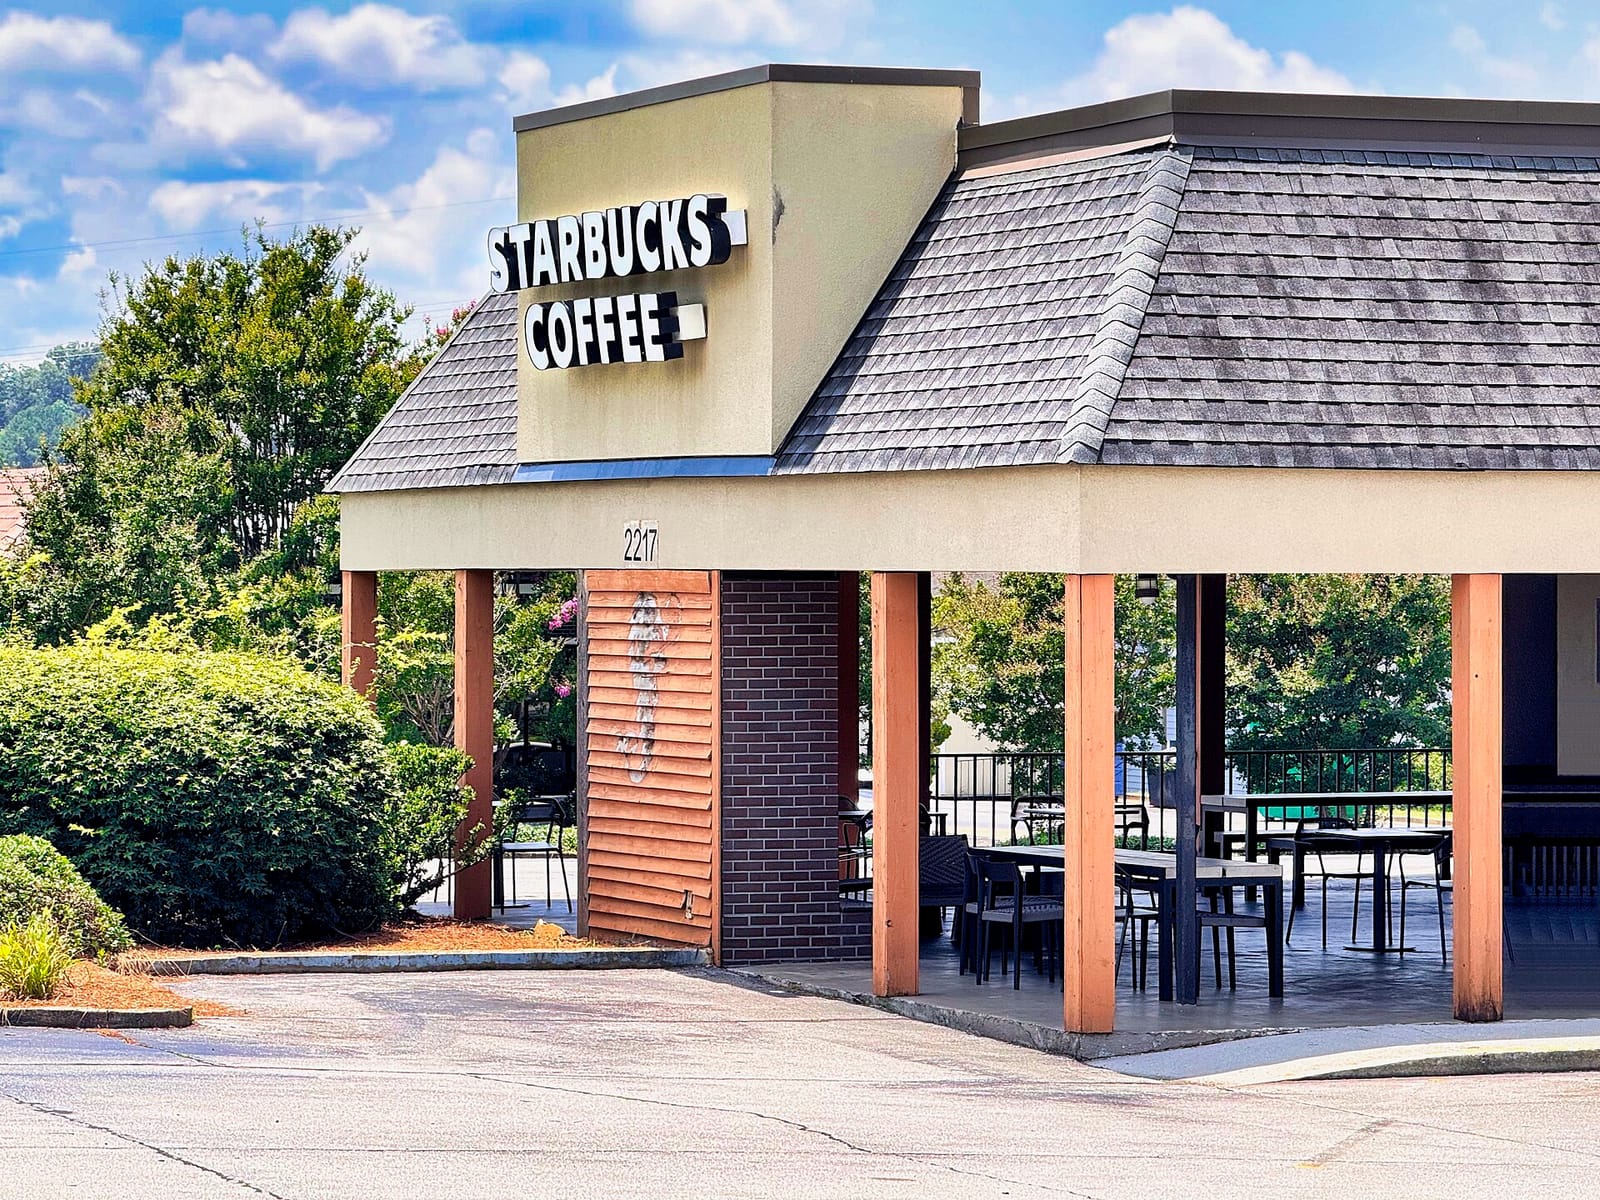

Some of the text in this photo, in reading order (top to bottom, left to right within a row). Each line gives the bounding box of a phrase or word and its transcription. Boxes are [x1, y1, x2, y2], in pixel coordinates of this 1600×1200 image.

[488, 194, 712, 293] STARBUCKS
[525, 293, 665, 370] COFFEE
[624, 528, 657, 561] 2217
